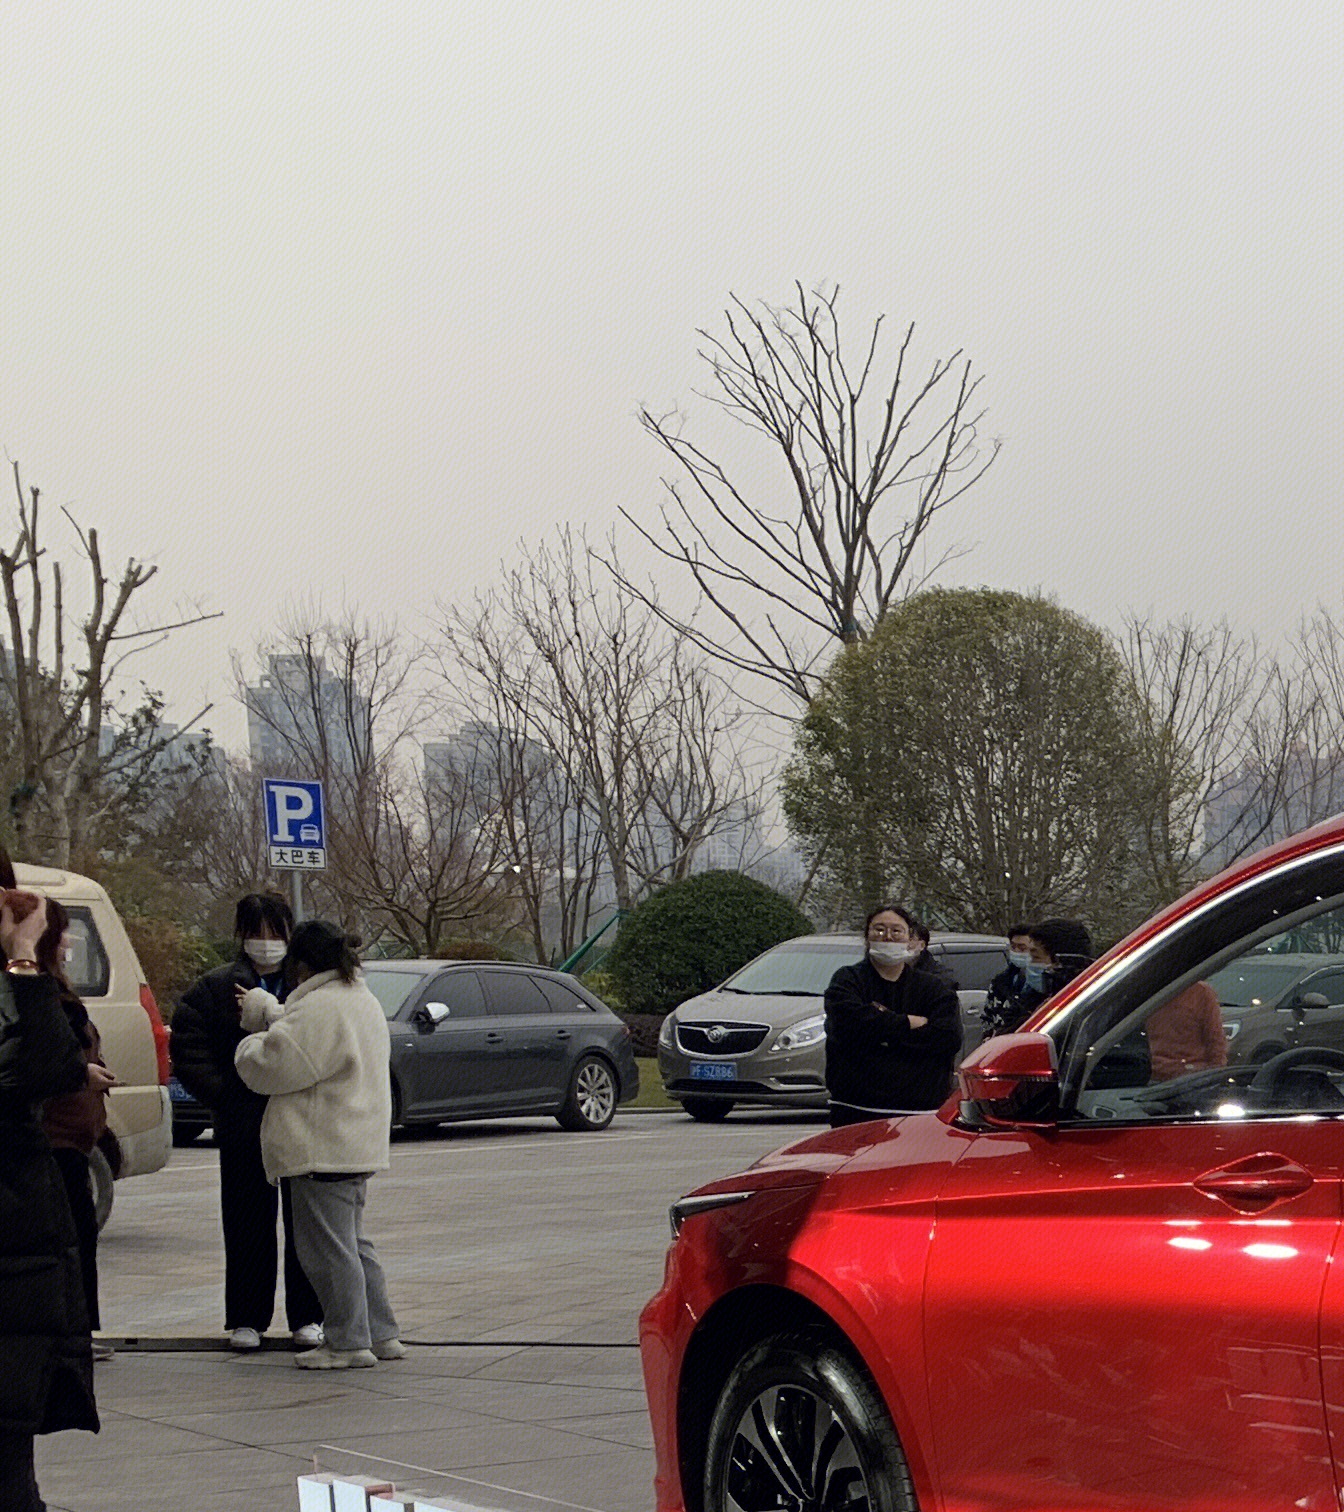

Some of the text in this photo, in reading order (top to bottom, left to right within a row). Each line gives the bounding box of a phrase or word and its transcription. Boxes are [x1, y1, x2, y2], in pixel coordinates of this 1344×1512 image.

[268, 785, 314, 842] P
[275, 849, 321, 865] 大巴车
